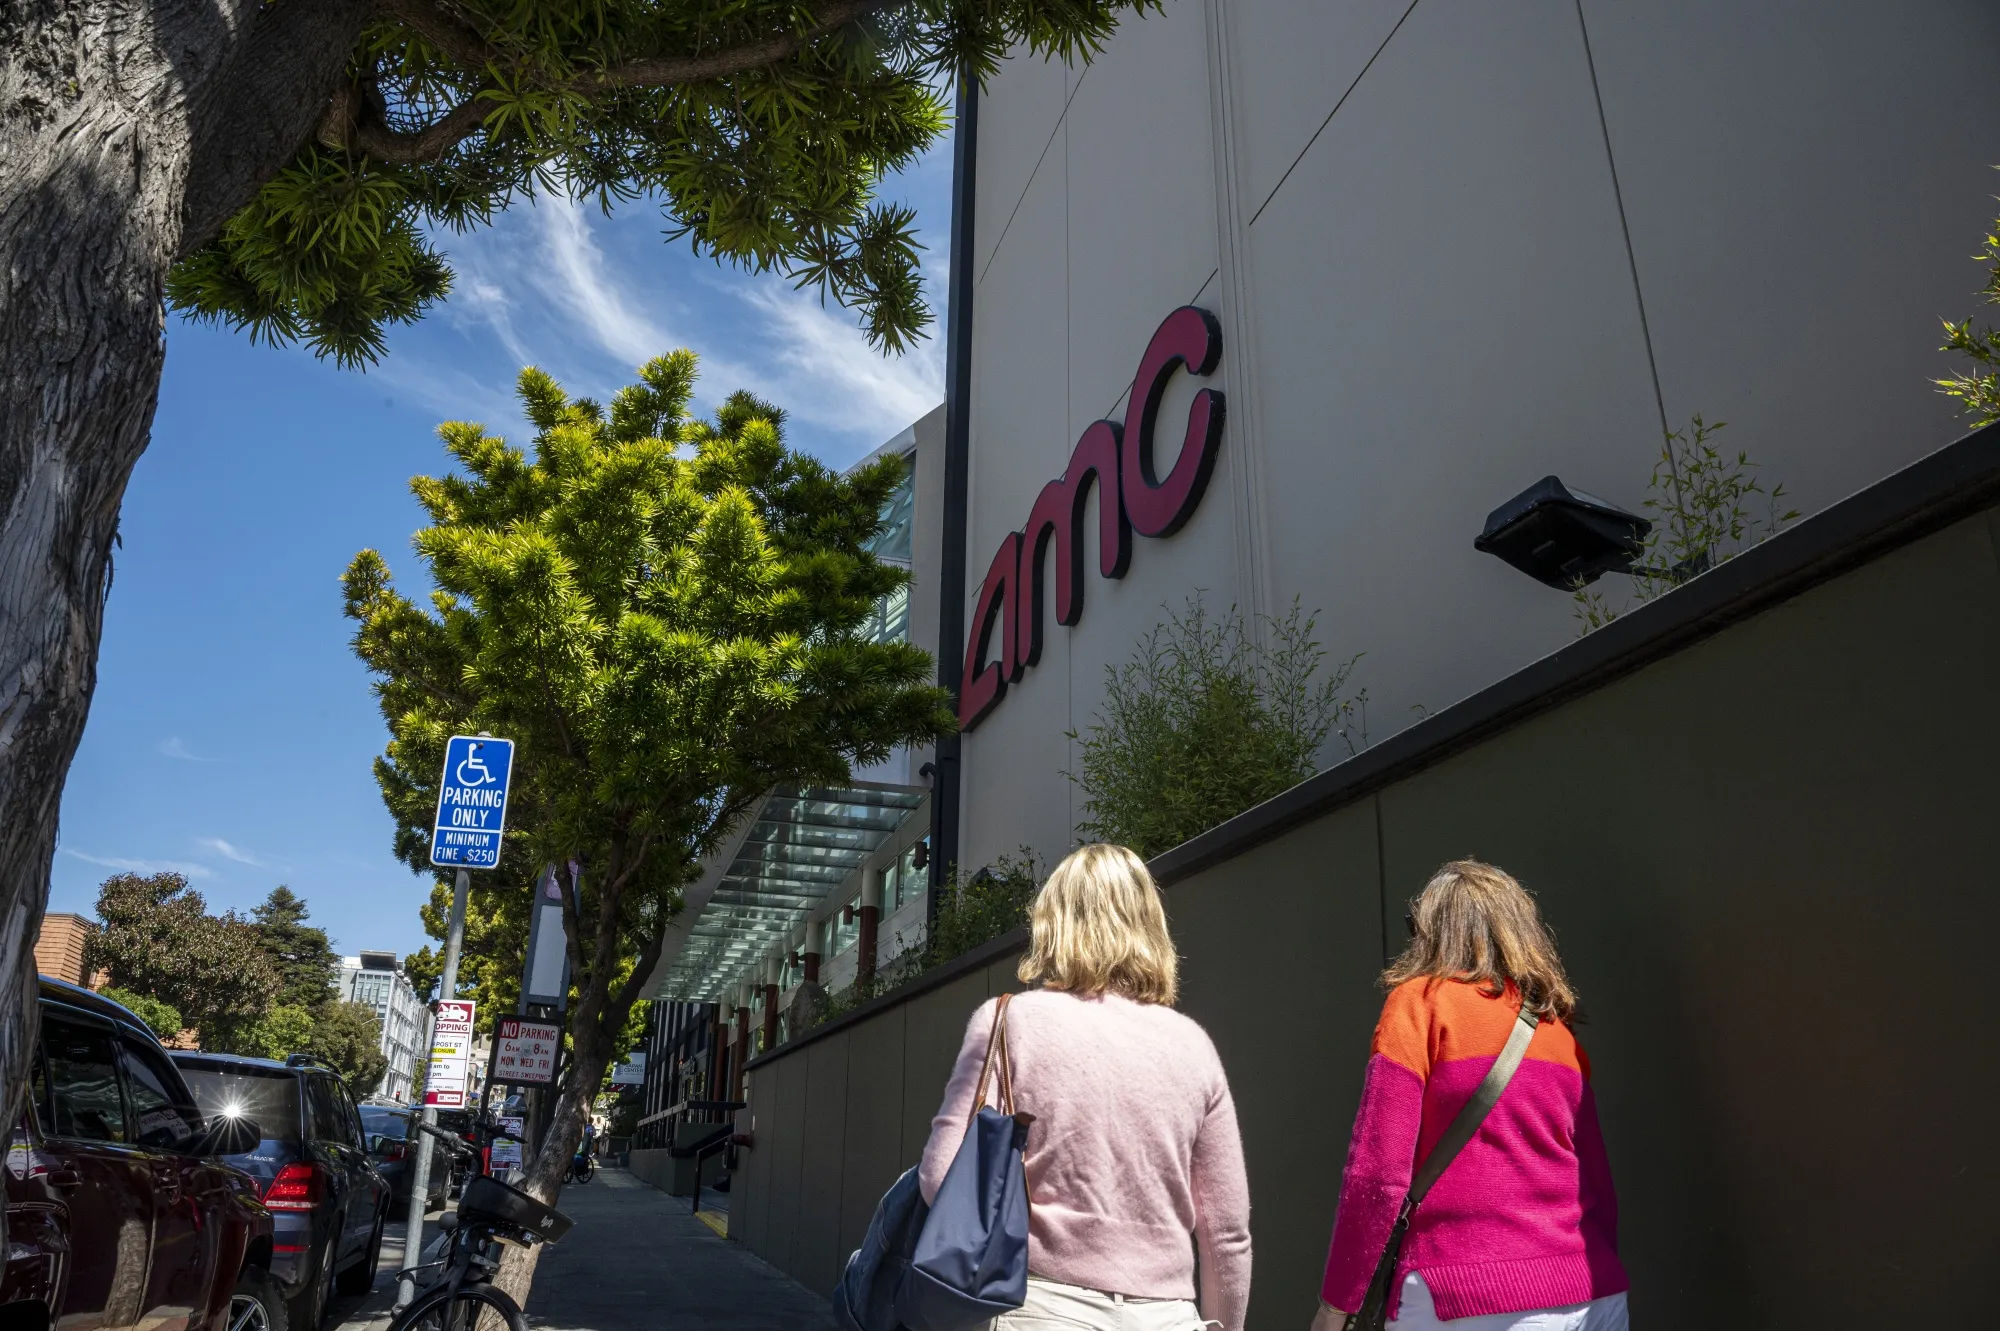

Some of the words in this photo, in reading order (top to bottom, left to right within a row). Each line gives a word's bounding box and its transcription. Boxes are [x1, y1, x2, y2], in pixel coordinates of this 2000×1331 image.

[958, 305, 1226, 733] amc
[444, 787, 502, 808] PARKING
[452, 808, 489, 827] ONLY
[445, 832, 490, 847] MINIMUM
[435, 847, 459, 860] FINE
[466, 848, 495, 863] $250
[435, 1023, 468, 1031] OPPING
[501, 1021, 518, 1038] NO
[520, 1027, 556, 1041] PARKING
[500, 1056, 516, 1067] MON
[520, 1057, 534, 1068] WED
[538, 1060, 550, 1070] FRI
[498, 1070, 519, 1078] STREET
[520, 1071, 548, 1080] SWEEPING
